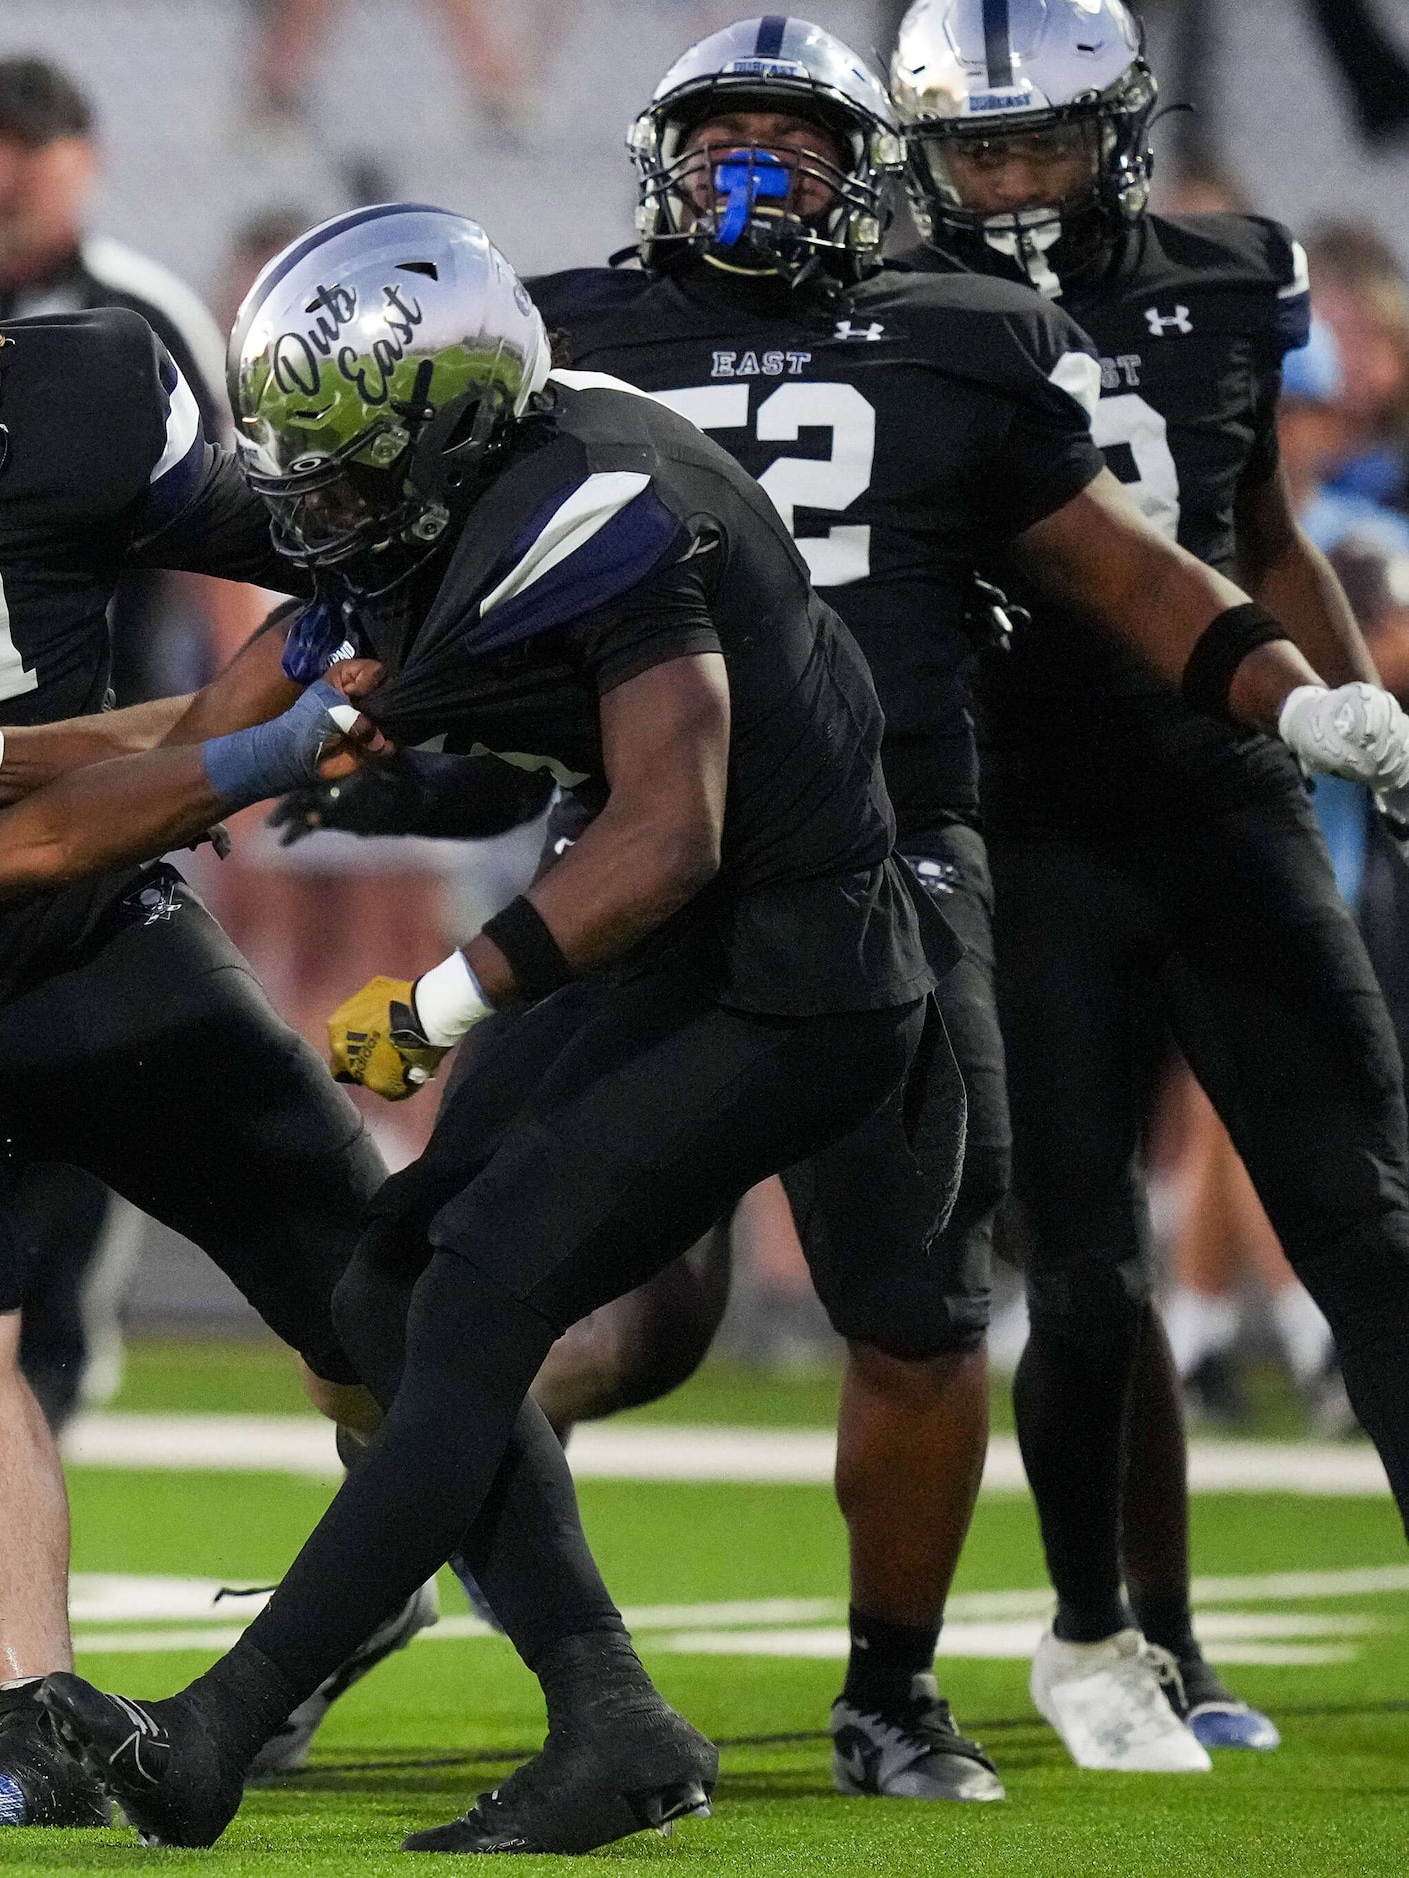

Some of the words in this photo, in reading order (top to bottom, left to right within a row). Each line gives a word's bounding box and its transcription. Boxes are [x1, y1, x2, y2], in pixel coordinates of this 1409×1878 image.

[273, 283, 357, 397] Dub
[337, 284, 423, 406] East
[710, 351, 812, 377] EAST
